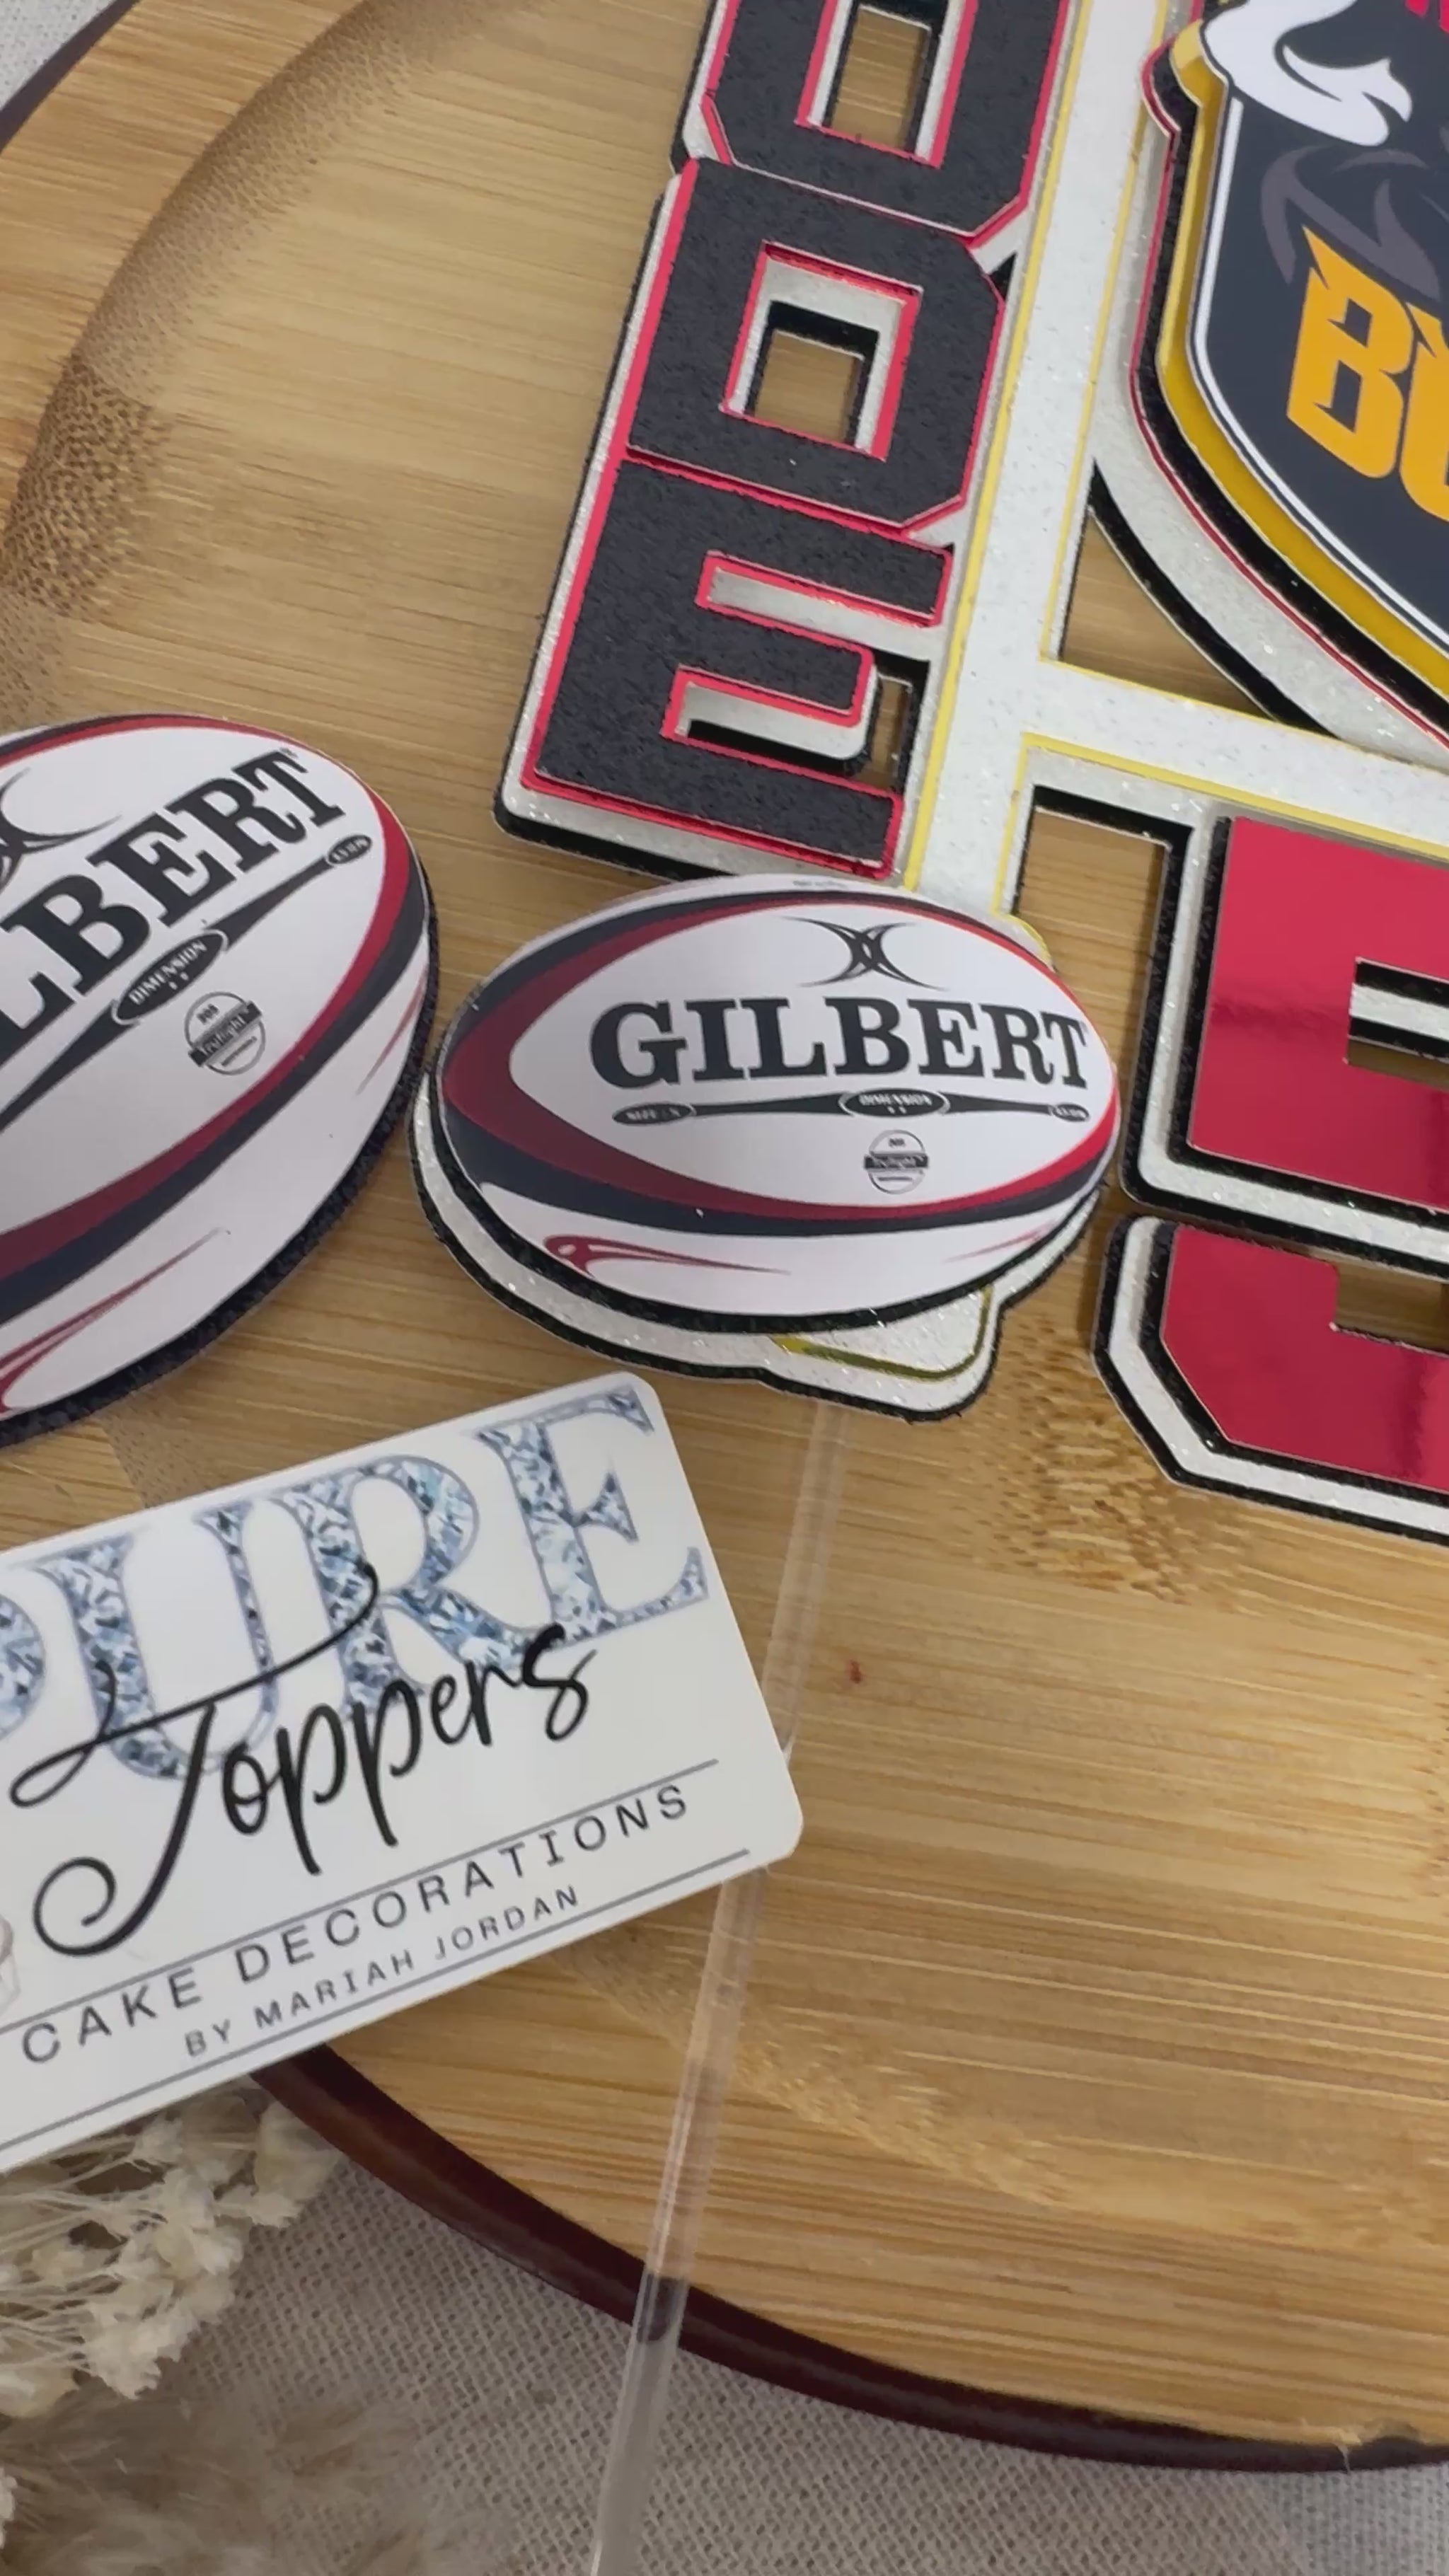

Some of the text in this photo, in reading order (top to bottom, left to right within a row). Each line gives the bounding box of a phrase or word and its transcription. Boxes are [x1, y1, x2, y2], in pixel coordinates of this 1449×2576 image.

[589, 995, 1090, 1089] GILBERT
[0, 1384, 708, 1779] URE
[10, 1562, 599, 1957] Toppers
[22, 1783, 688, 2064] CAKE DECORATIONS
[185, 1885, 580, 2057] BY MARIAH JORDAN
